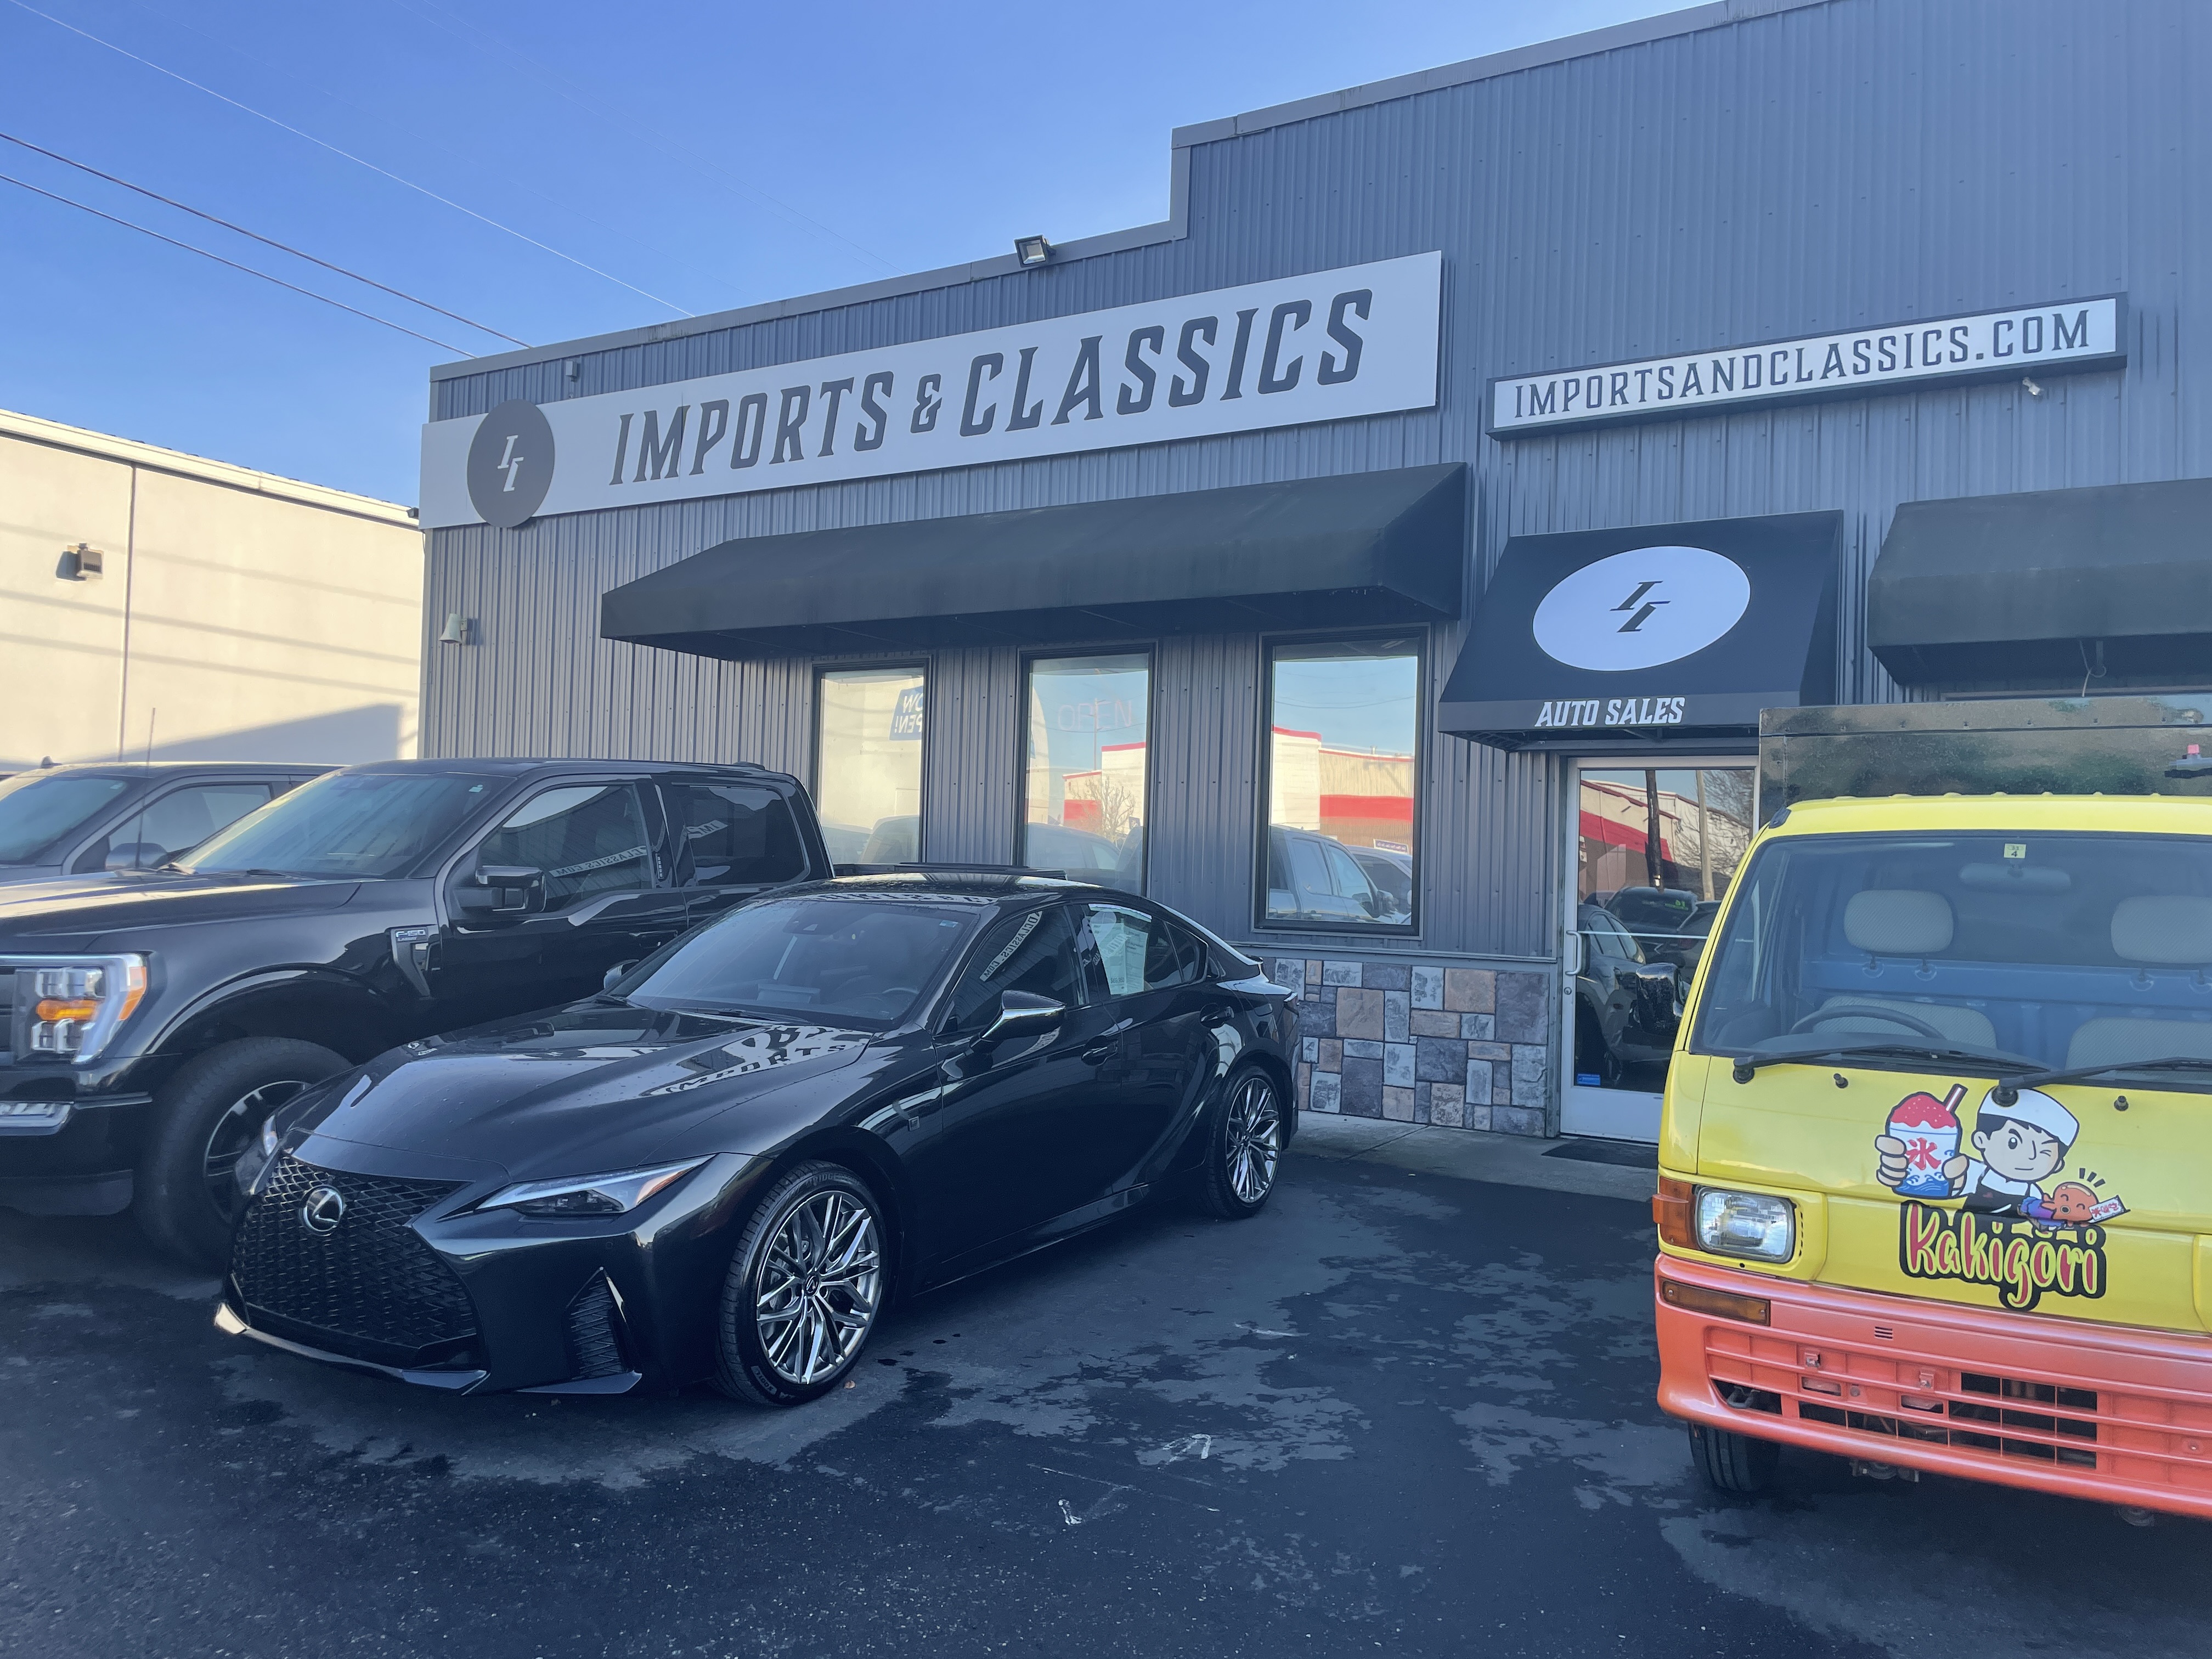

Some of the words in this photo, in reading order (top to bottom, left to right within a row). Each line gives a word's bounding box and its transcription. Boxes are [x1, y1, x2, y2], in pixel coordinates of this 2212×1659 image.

[1514, 309, 2090, 418] IMPORTSANDCLASSICS.COM
[609, 371, 894, 486] IMPORTS
[910, 374, 941, 434] &
[959, 289, 1373, 437] CLASSICS
[1058, 699, 1132, 732] OPEN
[1534, 699, 1599, 727] AUTO
[1605, 697, 1685, 725] SALES
[396, 929, 426, 938] F-150
[1905, 1137, 1942, 1170] 氷
